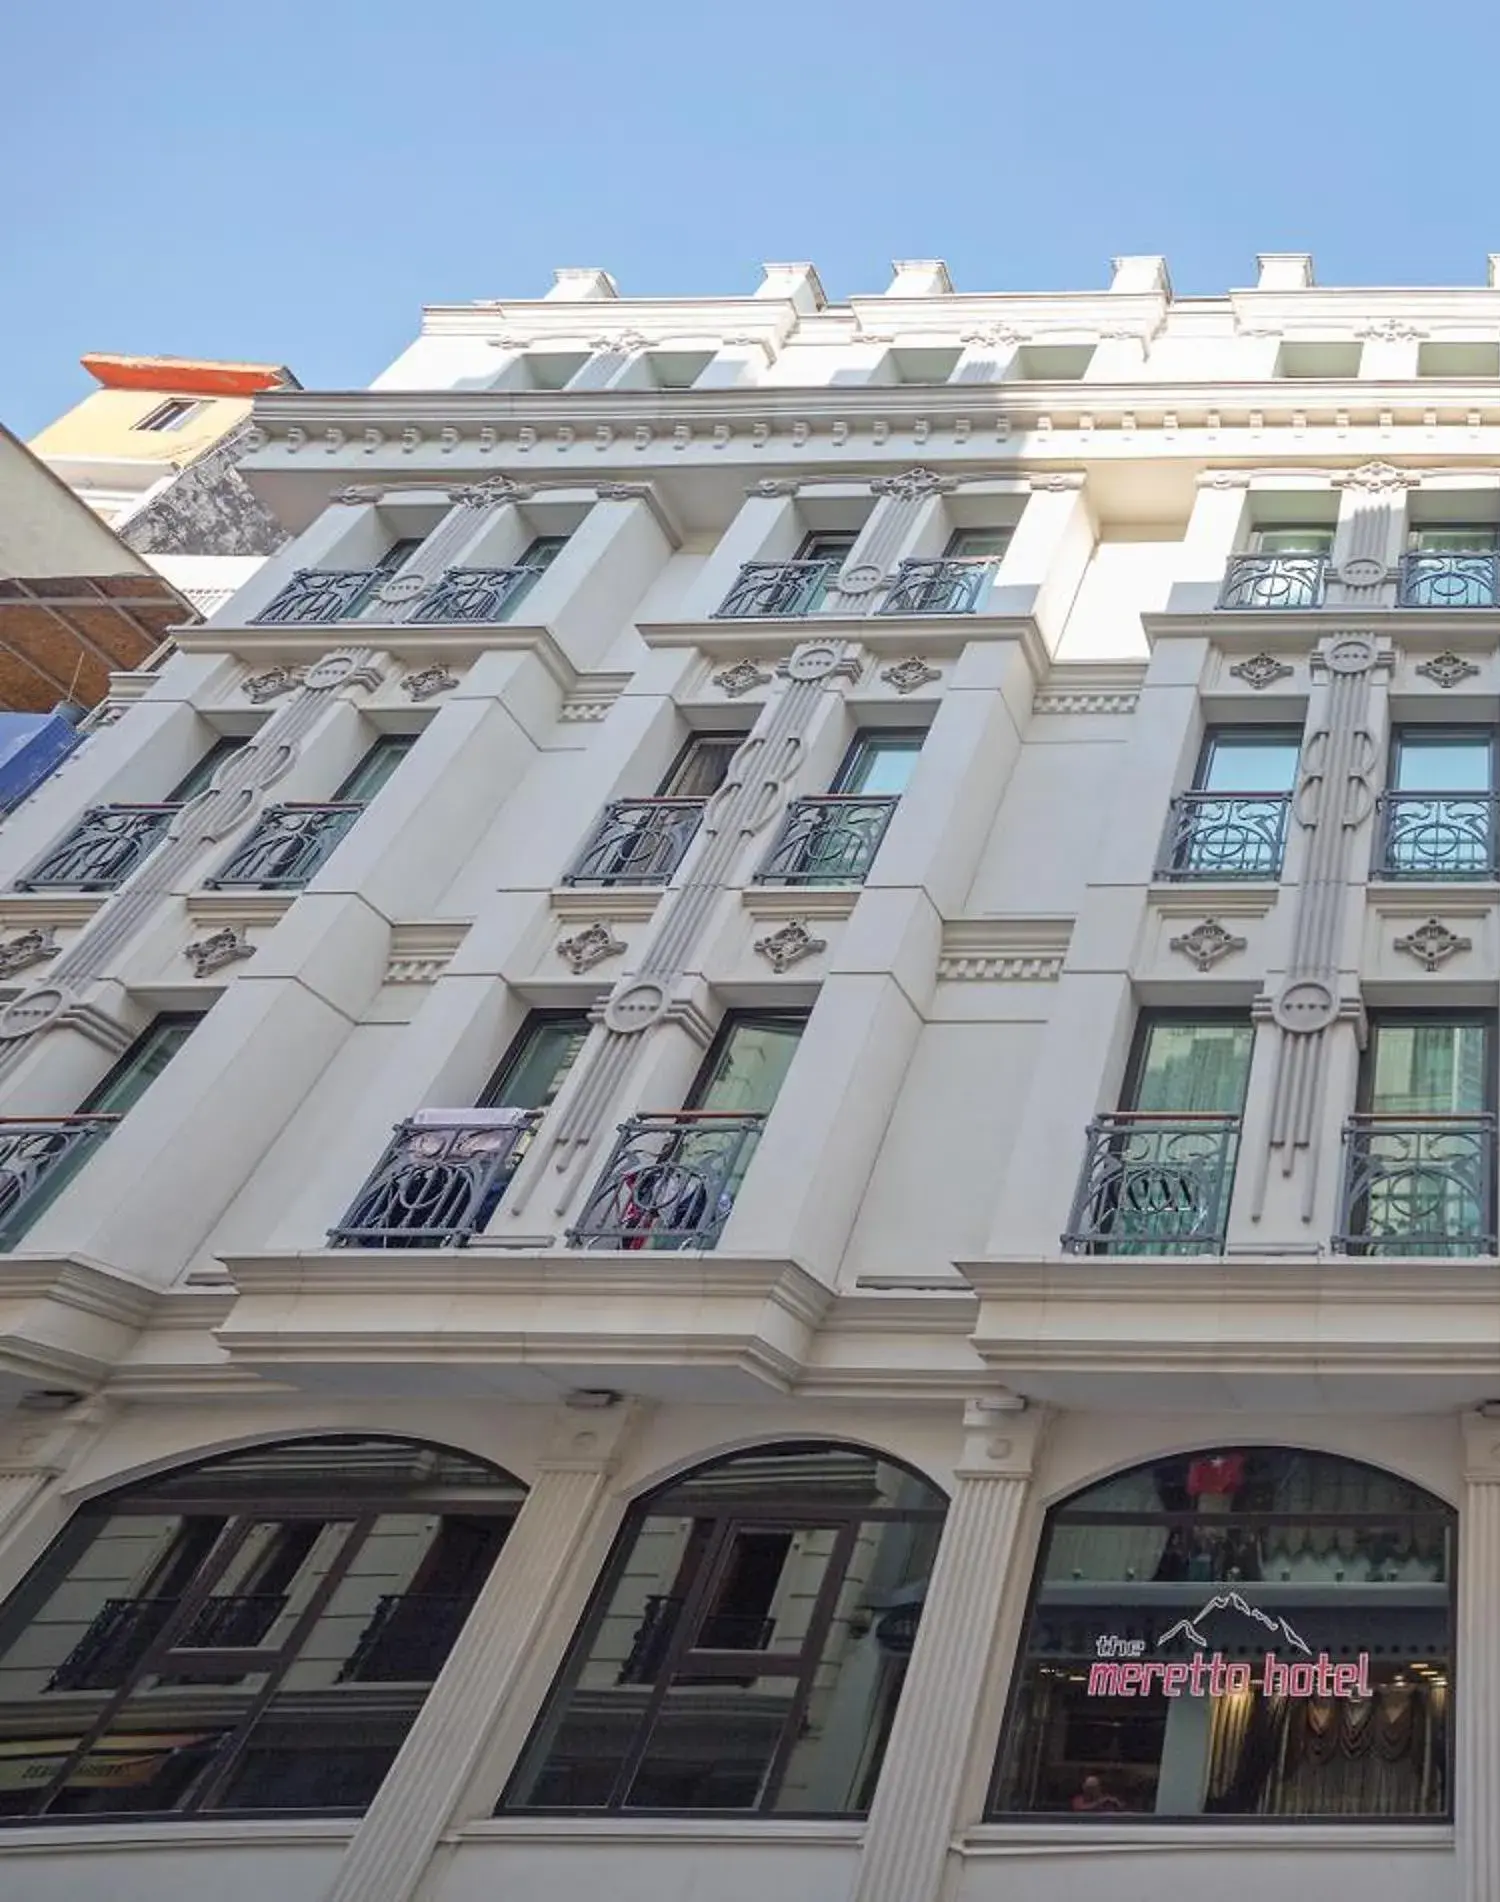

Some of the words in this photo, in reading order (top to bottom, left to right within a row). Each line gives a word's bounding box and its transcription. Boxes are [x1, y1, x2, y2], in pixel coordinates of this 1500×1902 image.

[1096, 1635, 1146, 1657] the
[1087, 1652, 1251, 1697] meretto
[1263, 1652, 1374, 1697] hotel
